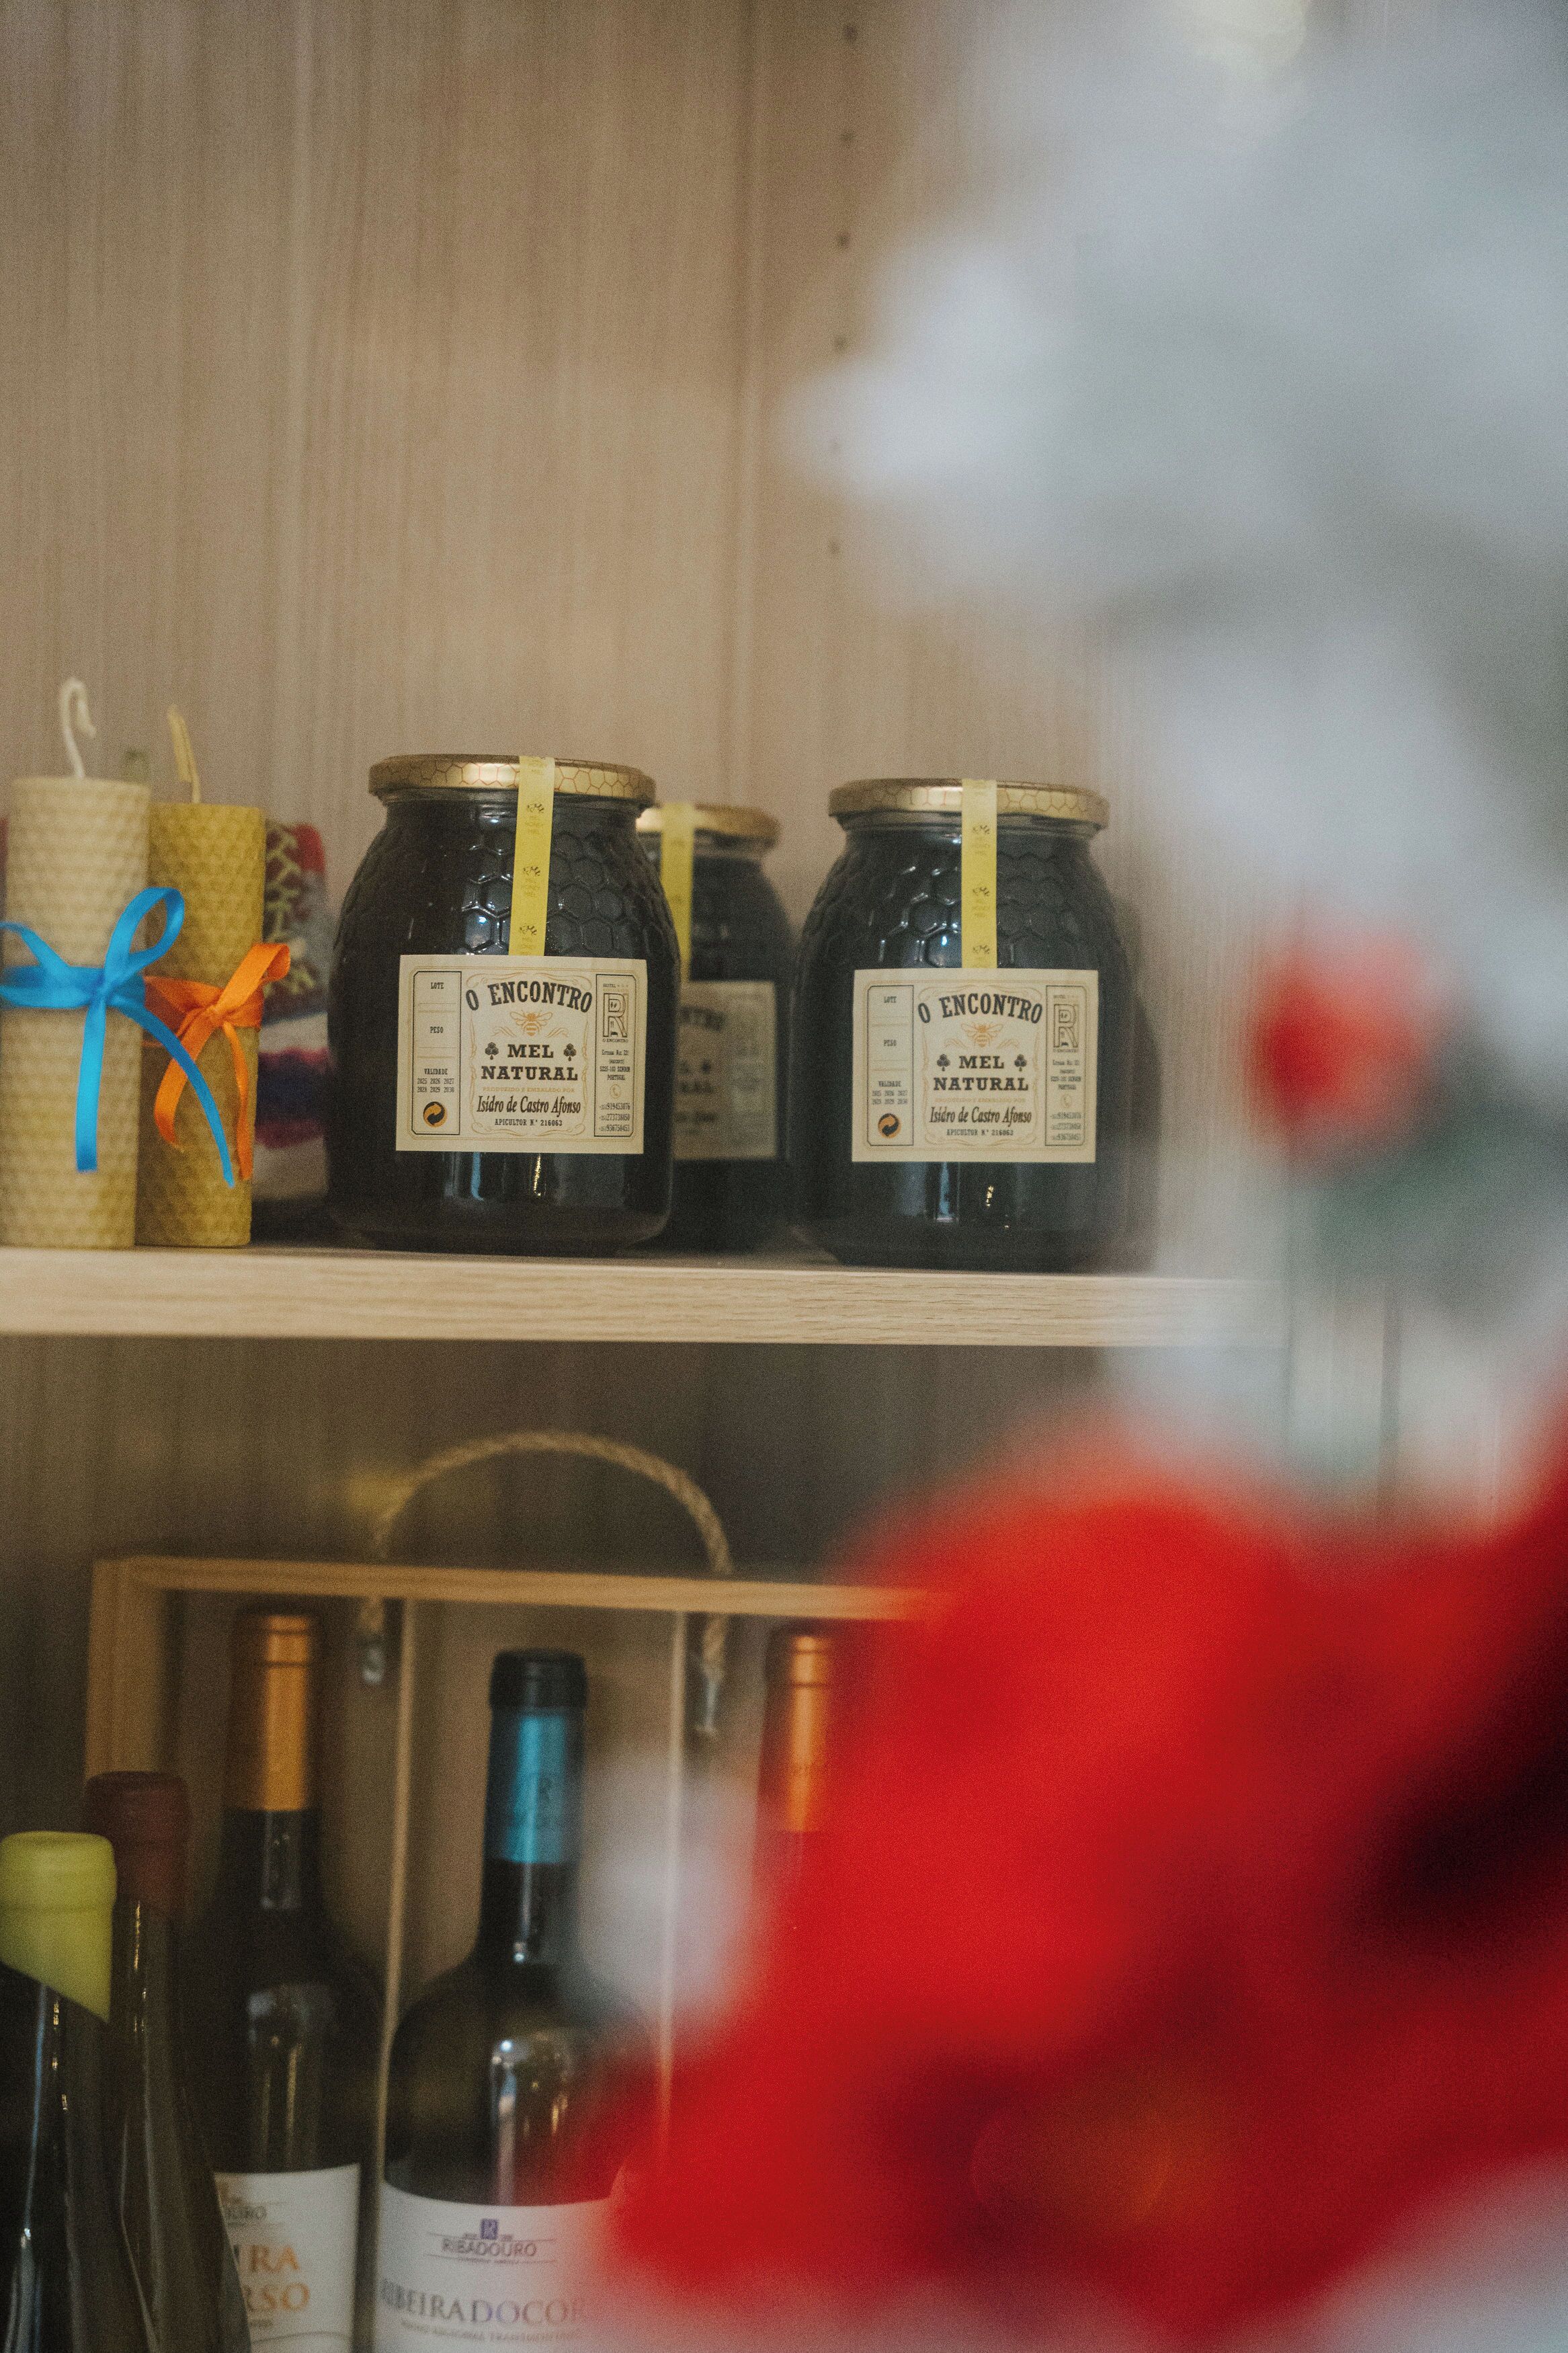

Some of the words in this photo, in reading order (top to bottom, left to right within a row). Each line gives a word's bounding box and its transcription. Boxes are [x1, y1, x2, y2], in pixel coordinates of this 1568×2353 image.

[465, 989, 479, 1010] O
[487, 980, 593, 1012] ENCONTRO
[917, 1002, 932, 1024] O
[938, 993, 1043, 1024] ENCONTRO
[507, 1043, 554, 1058] MEL
[958, 1055, 1005, 1069] MEL
[481, 1066, 579, 1081] NATURAL
[933, 1077, 1029, 1091] NATURAL
[506, 1094, 518, 1113] de
[520, 1095, 550, 1114] Castro
[550, 1095, 581, 1118] Afonso
[495, 1118, 527, 1126] APICULTOR
[958, 1106, 969, 1123] de
[971, 1106, 1000, 1123] Castro
[1002, 1106, 1032, 1127] Afonso
[441, 2238, 537, 2258] RIBADOURO
